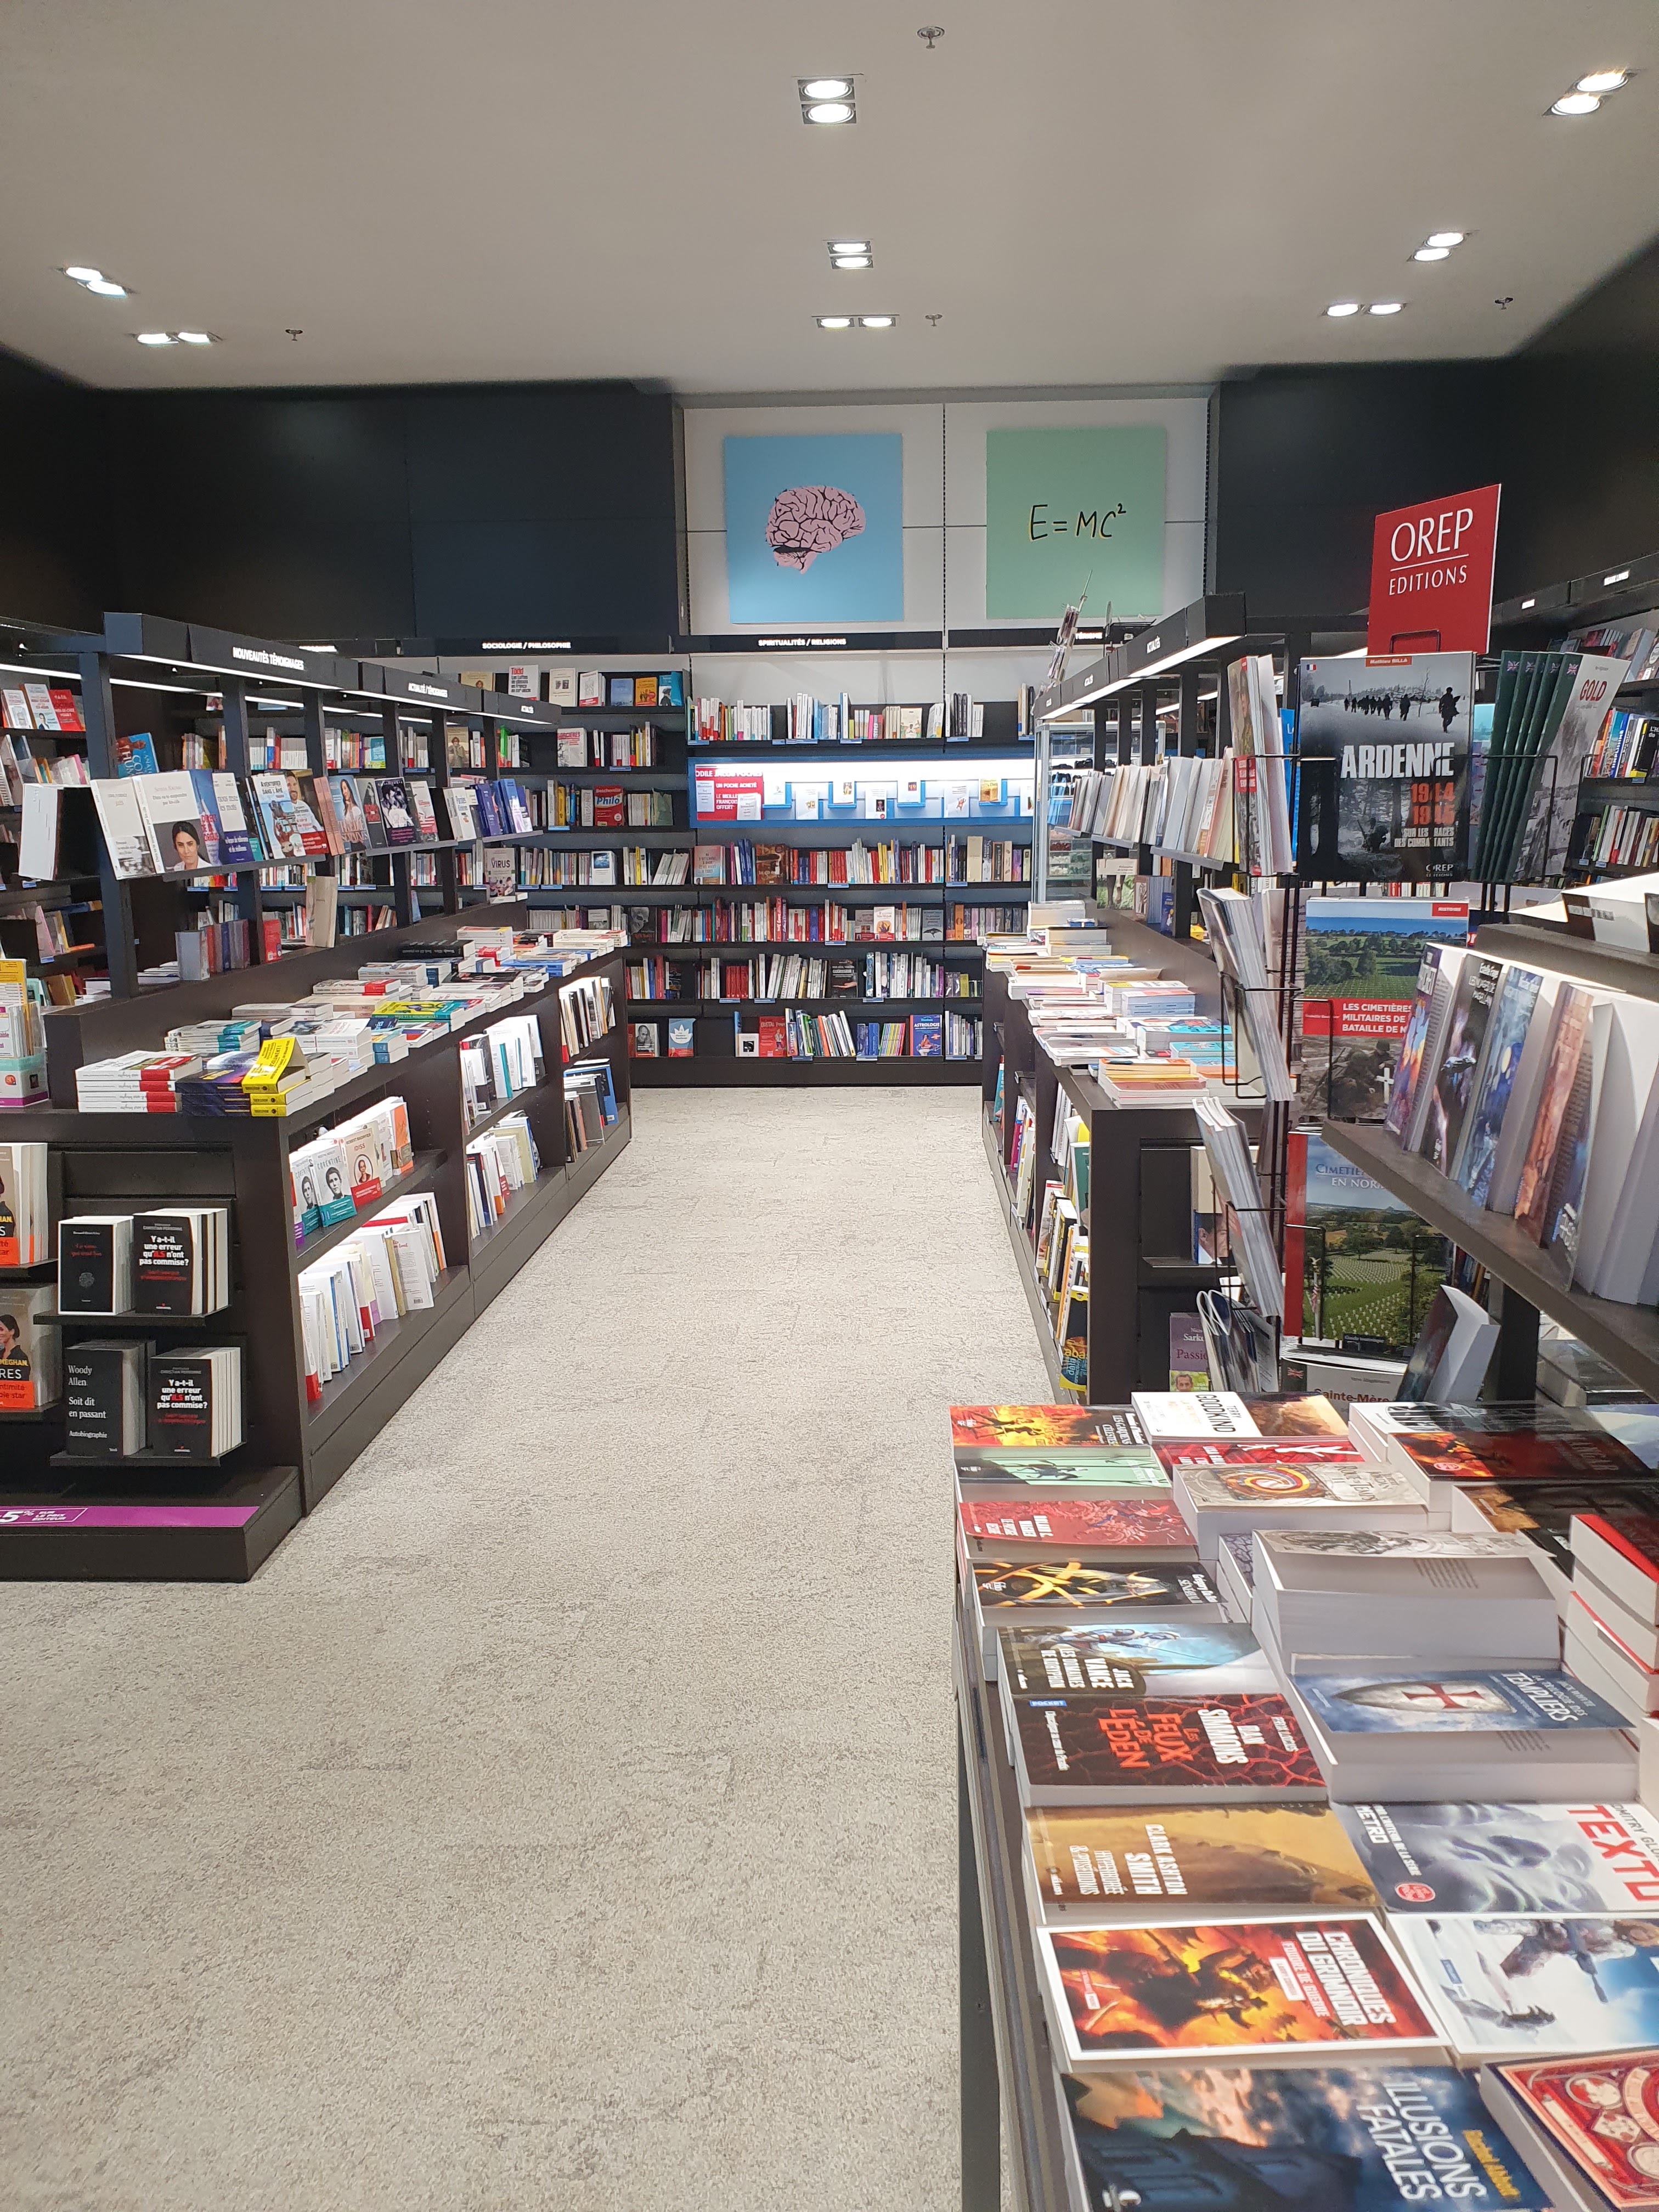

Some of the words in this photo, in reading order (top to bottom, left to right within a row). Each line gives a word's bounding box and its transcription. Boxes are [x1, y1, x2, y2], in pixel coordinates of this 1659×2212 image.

[1390, 508, 1474, 562] OREP
[1389, 565, 1468, 596] EDITIONS
[233, 647, 269, 664] NOUVEAUTÉS
[269, 653, 304, 670] TÉMOIGNAGES
[1579, 678, 1607, 703] GOLD
[1340, 742, 1455, 778] ARDENNE
[597, 797, 620, 805] Philo
[1407, 837, 1454, 848] COMBATANTS
[1418, 827, 1429, 837] LES
[1431, 827, 1454, 837] RACES
[491, 860, 510, 868] VIRUS
[1342, 1014, 1392, 1023] MILITAIRES
[1342, 1024, 1384, 1032] BATAILLE
[354, 1143, 365, 1152] IDISS
[317, 1155, 341, 1170] CORENTINE
[1331, 1177, 1346, 1187] EN
[68, 1365, 92, 1376] Woody
[68, 1377, 87, 1386] Allen
[69, 1396, 83, 1406] Soit
[84, 1397, 95, 1406] dit
[1313, 1389, 1390, 1403] Sainte-Mère
[79, 1410, 106, 1419] passant
[1195, 1394, 1237, 1432] GOODKIND
[1227, 1406, 1242, 1418] TERRY
[69, 1430, 108, 1438] Autobiographie
[1334, 1466, 1361, 1480] ROUE
[1059, 1648, 1076, 1657] LES
[1062, 1657, 1085, 1689] DOMAINES
[1084, 1658, 1114, 1688] VANCE
[1112, 1668, 1135, 1689] JACK
[1501, 1672, 1579, 1722] TEMPLIERS
[1098, 1709, 1151, 1768] L'ÉDEN
[1134, 1730, 1153, 1743] DE
[1147, 1713, 1194, 1762] FEUX
[1183, 1728, 1199, 1742] LES
[1198, 1709, 1249, 1764] SIMMONS
[1237, 1725, 1266, 1745] DAN
[1354, 1805, 1390, 1843] METRO
[1145, 1824, 1173, 1854] CLARK
[1567, 1804, 1659, 1901] TEXTO
[1124, 1852, 1163, 1894] SMITH
[1155, 1854, 1188, 1895] ASHTON
[1295, 1931, 1328, 1953] DU
[1296, 1972, 1313, 1985] DE
[1323, 1931, 1397, 2024] CHRONIQUES
[1308, 1951, 1368, 2027] GRIMNOIR
[1382, 2081, 1487, 2198] ILLUSIONS
[1355, 2104, 1443, 2199] FATALES
